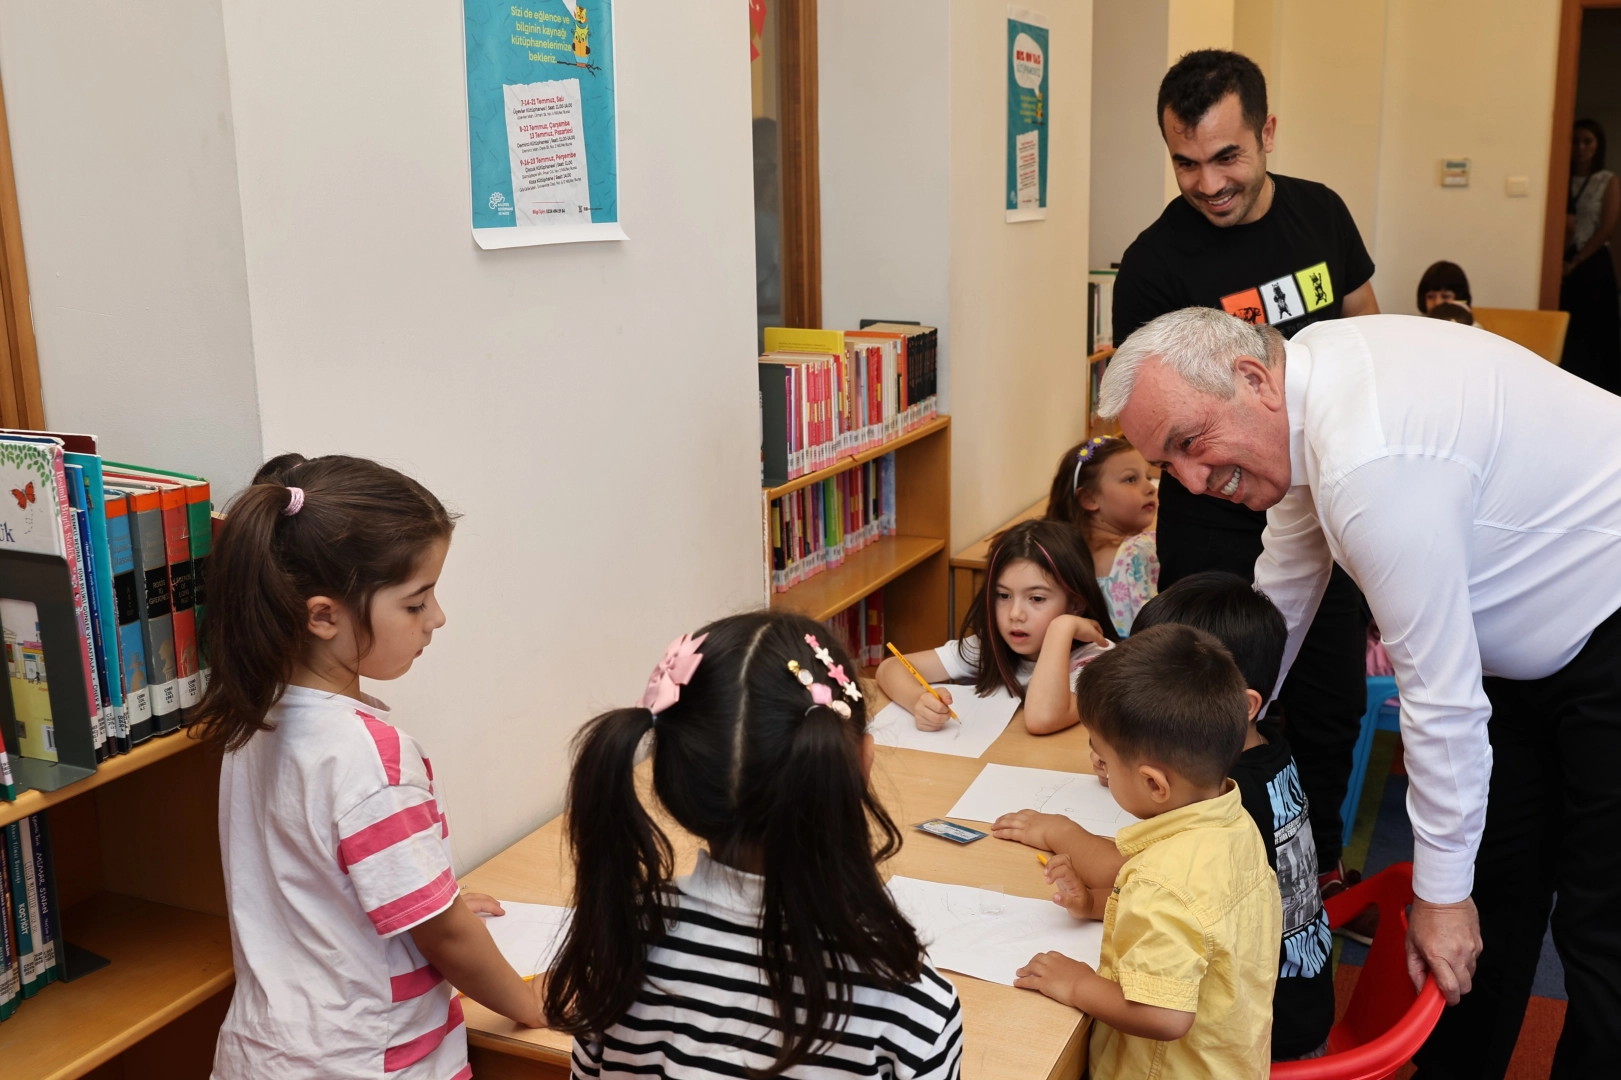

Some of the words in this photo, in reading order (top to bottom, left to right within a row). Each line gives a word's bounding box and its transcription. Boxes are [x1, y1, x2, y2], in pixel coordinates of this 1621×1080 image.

[511, 6, 522, 17] Sizi
[524, 8, 532, 18] de
[534, 11, 562, 22] eğlence
[563, 16, 570, 24] ve
[511, 34, 572, 52] kütüphanelerimize
[516, 21, 540, 34] bilginin
[542, 25, 566, 40] kaynağı
[56, 470, 66, 501] Resimli
[61, 504, 70, 530] Büyük
[66, 532, 75, 560] Sözlük
[87, 642, 96, 674] HAFTALAR
[36, 852, 45, 885] MİMAR
[40, 887, 48, 914] SİNAN
[18, 902, 28, 935] KOÇYİĞİT
